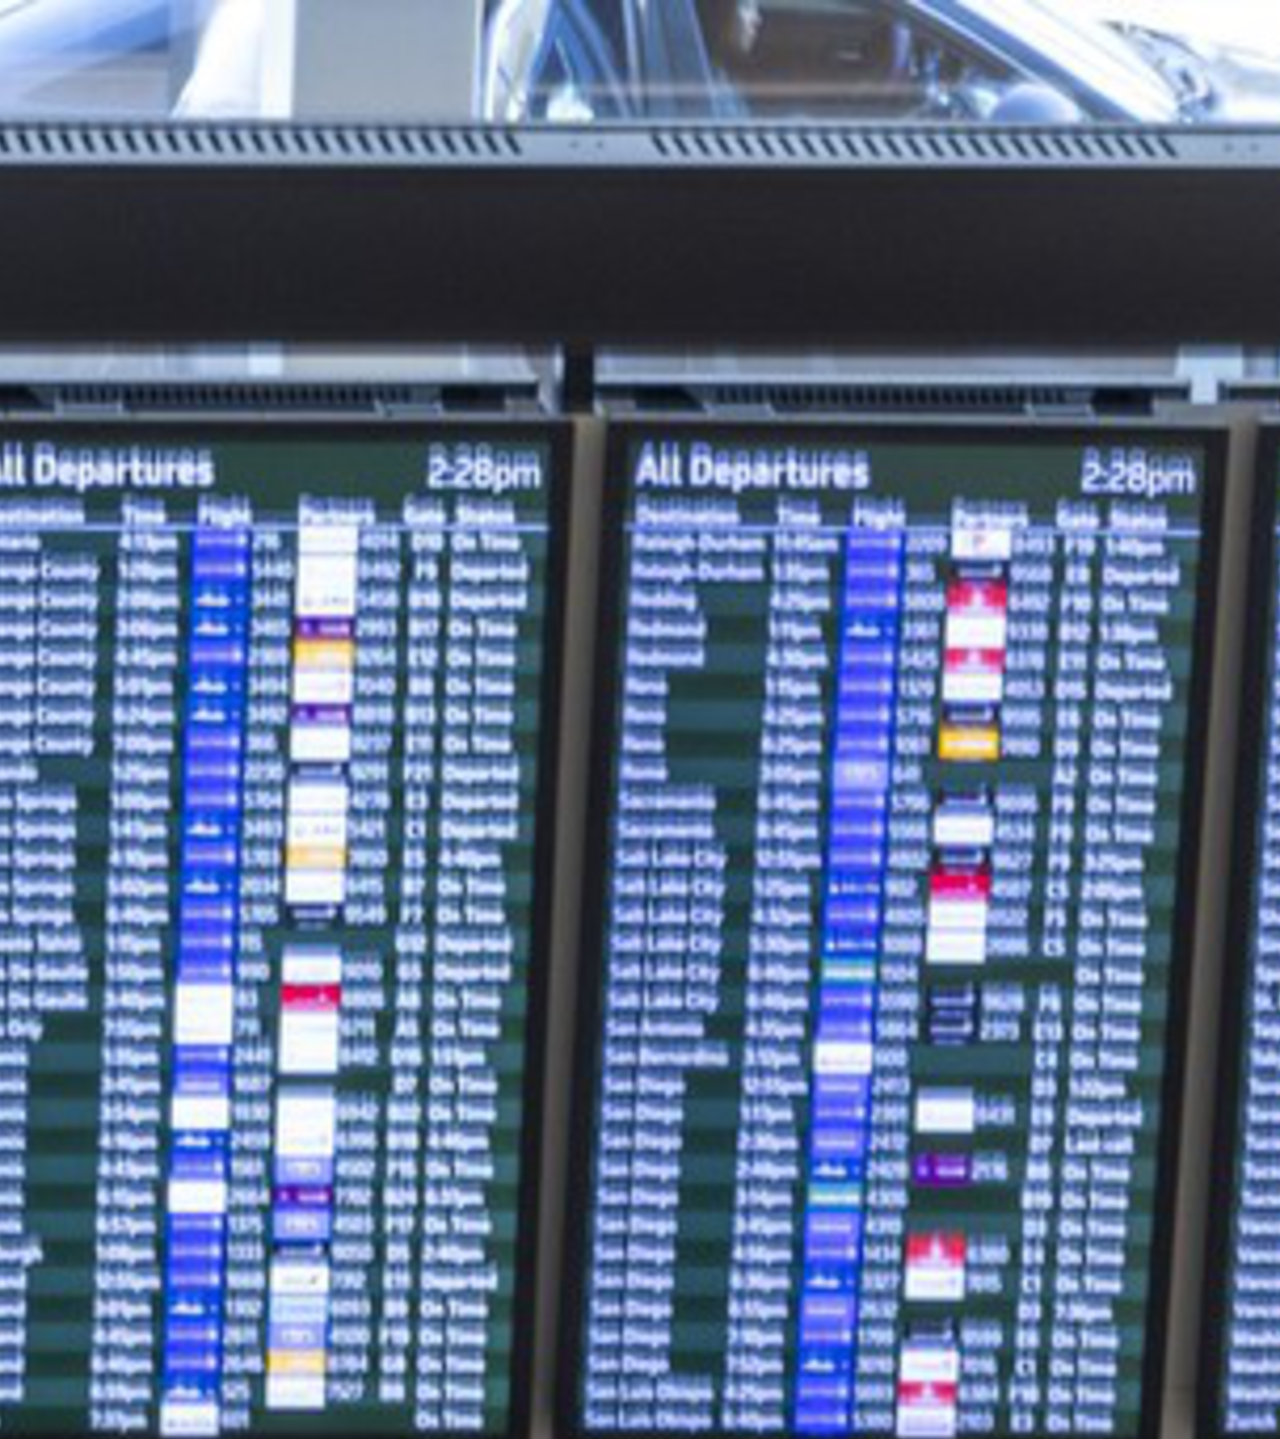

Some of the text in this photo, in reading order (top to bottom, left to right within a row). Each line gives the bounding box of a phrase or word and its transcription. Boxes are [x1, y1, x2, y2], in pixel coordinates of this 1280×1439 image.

[32, 449, 214, 491] Departures
[427, 450, 542, 492] 2:28pm
[636, 451, 870, 492] All Departures
[1080, 454, 1196, 495] 2:28pm
